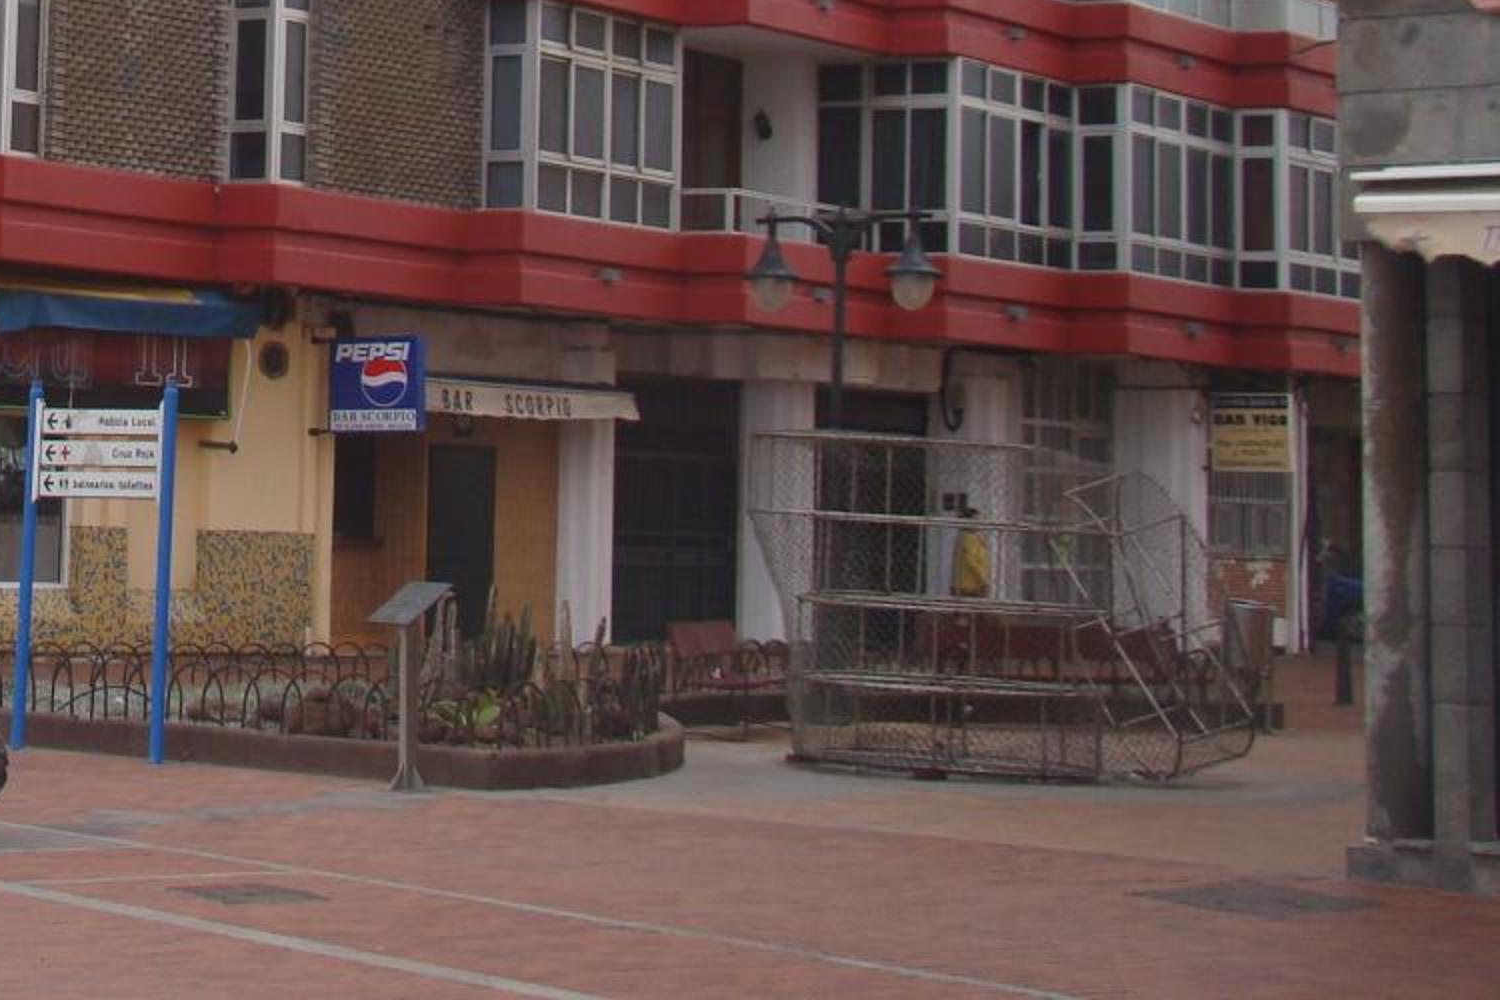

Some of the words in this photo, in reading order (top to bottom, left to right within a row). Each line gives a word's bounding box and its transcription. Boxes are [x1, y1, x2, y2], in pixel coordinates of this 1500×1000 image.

[334, 341, 411, 363] PEPSI
[442, 388, 474, 411] BAR
[504, 393, 572, 418] SCORPIO
